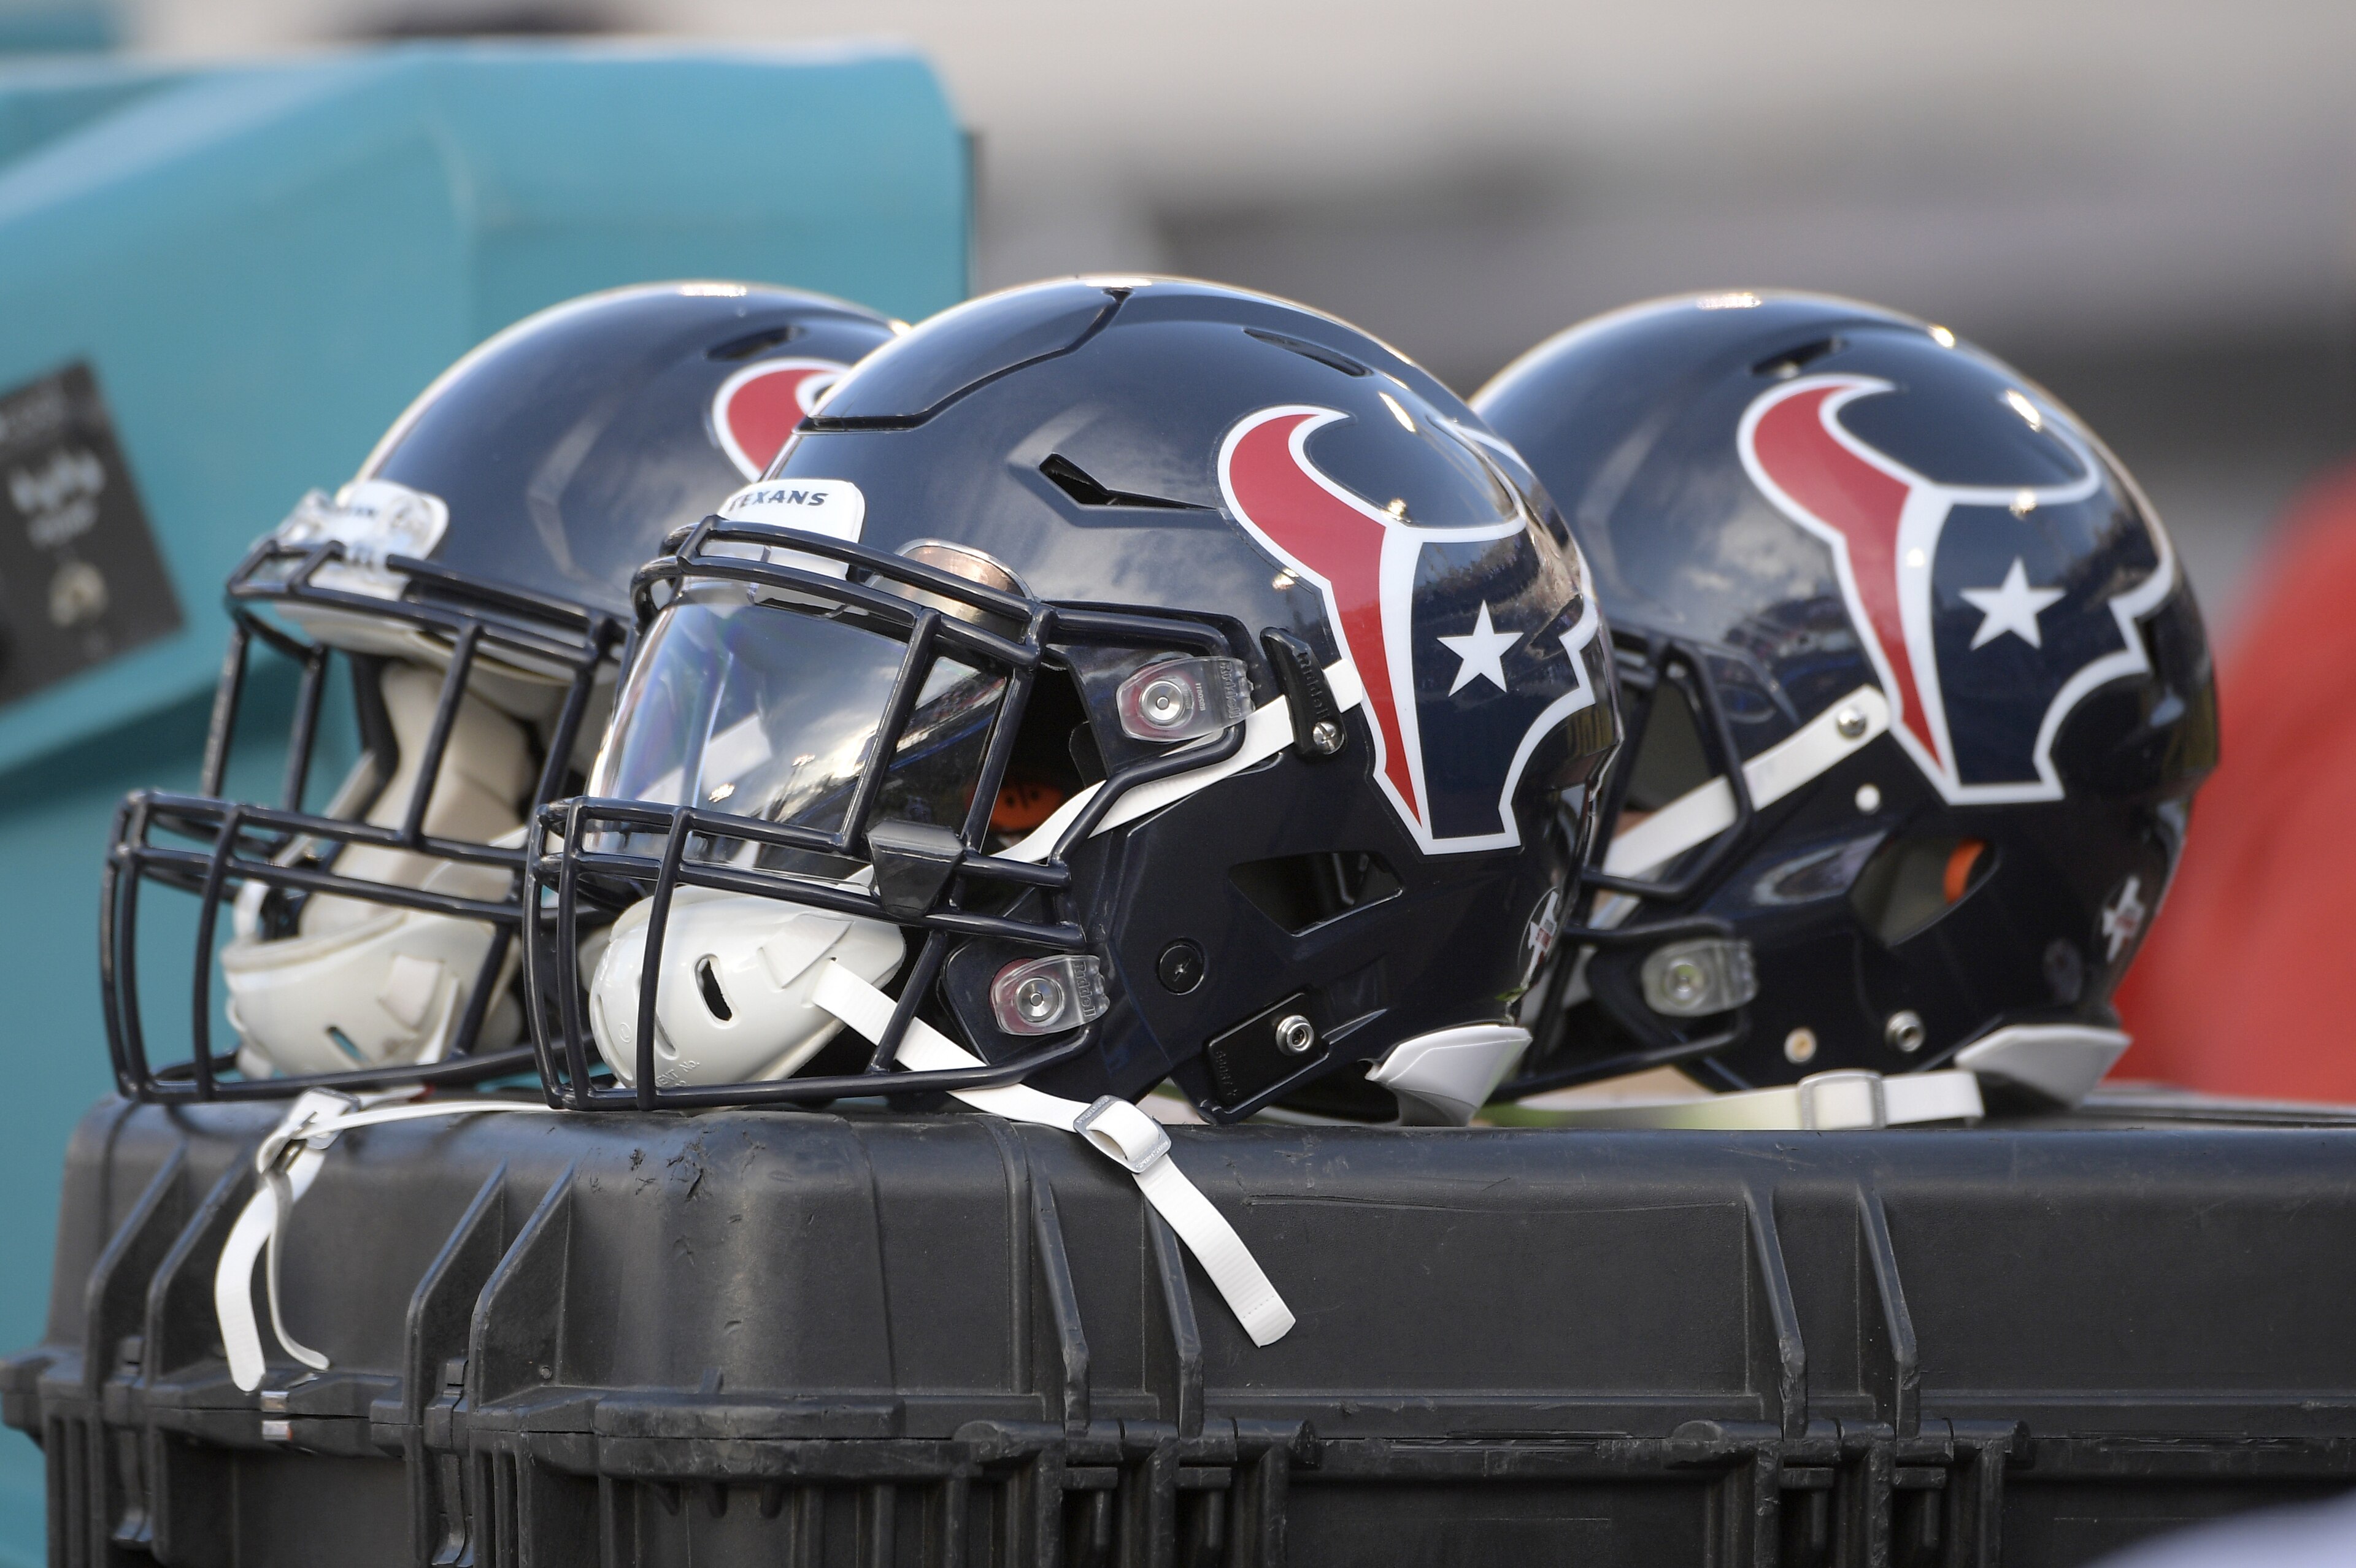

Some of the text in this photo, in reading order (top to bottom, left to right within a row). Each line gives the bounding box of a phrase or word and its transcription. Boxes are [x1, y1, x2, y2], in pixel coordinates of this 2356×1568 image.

[728, 490, 829, 512] TEXANS
[1220, 661, 1242, 720] Riddell
[1073, 961, 1097, 1018] Riddell
